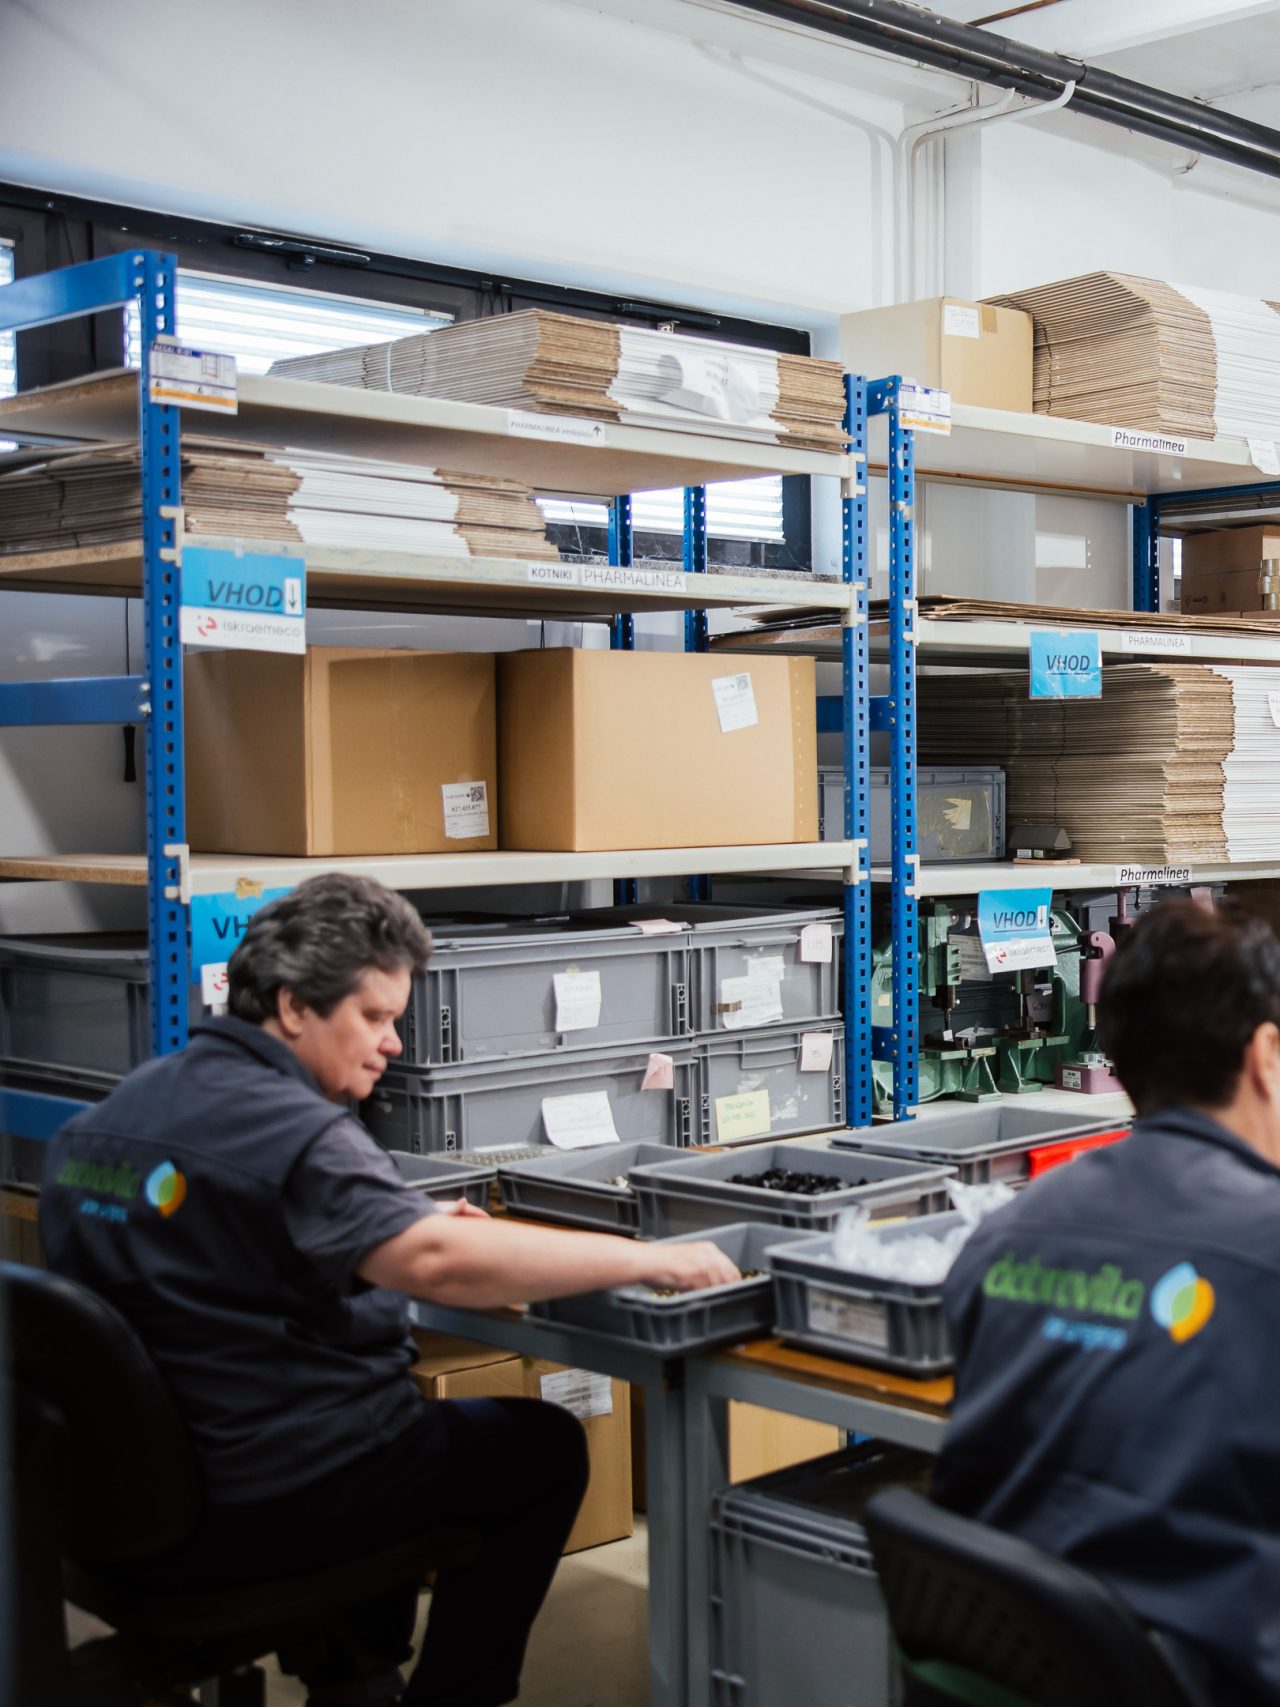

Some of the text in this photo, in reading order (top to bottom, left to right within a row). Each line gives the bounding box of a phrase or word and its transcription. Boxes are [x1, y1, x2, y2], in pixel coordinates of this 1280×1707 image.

[510, 421, 561, 434] PHARMALINEA
[1114, 431, 1185, 452] Pharmalinea
[531, 567, 573, 580] KOTNIKI
[584, 569, 683, 588] PHARMALINEA
[208, 579, 284, 608] VHOD
[1128, 635, 1185, 648] PHARMALINEA
[1046, 654, 1090, 671] VHOD
[1120, 866, 1189, 881] Pharmalinea
[212, 915, 253, 940] VH
[993, 911, 1037, 929] VHOD
